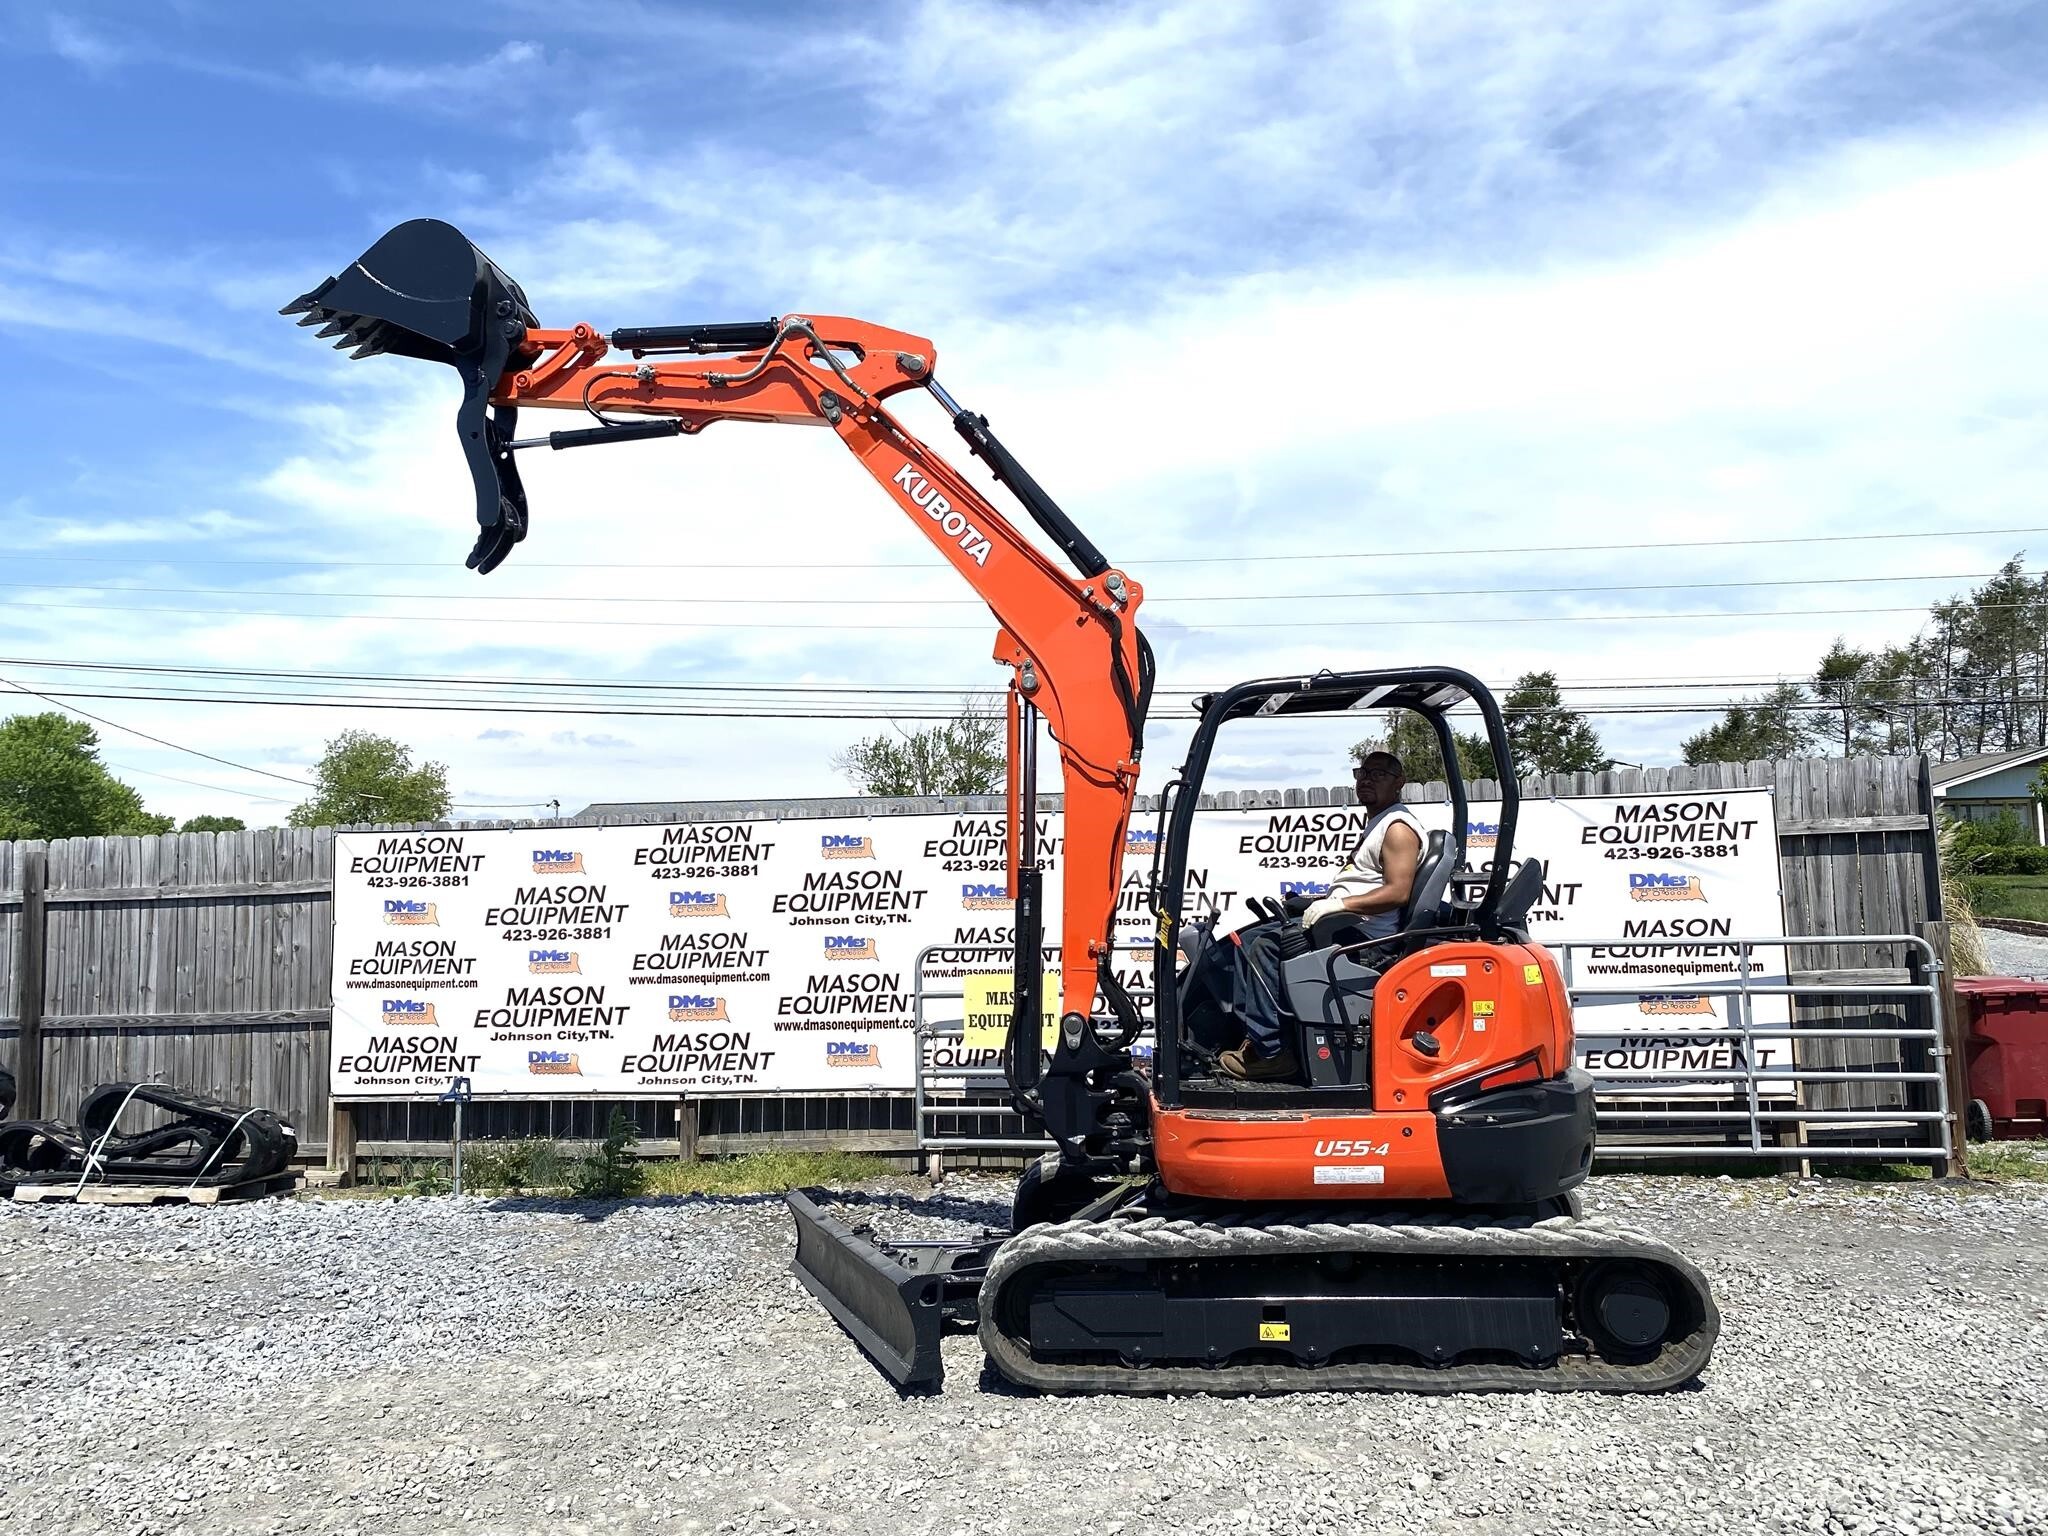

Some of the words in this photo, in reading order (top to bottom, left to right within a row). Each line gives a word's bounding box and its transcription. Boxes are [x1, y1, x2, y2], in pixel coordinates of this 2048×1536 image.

[892, 462, 993, 568] KUBOTA
[1614, 801, 1727, 823] MASON
[952, 819, 1048, 838] MASN
[1268, 813, 1368, 833] MASON
[662, 825, 752, 845] MASON
[1581, 821, 1758, 845] EQUIPMENT
[377, 837, 463, 855] MASON
[1239, 833, 1363, 853] EQUIPME
[1604, 844, 1739, 860] 423-926-3881
[634, 843, 775, 865] EQUIPMENT
[350, 855, 485, 873] EQUIPMENT
[652, 865, 759, 879] 423-926-3881
[367, 876, 469, 888] 423-926-3881
[803, 870, 902, 891] MASON
[514, 885, 606, 905] MASON
[772, 890, 928, 913] EQUIPMENT
[485, 904, 629, 926] EQUIPMENT
[789, 915, 849, 926] Johnson
[855, 914, 912, 926] City,TN.
[502, 927, 612, 941] 423-926-3881
[1623, 918, 1731, 938] MASON
[374, 940, 456, 957] MASON
[660, 932, 748, 950] MASON
[350, 958, 476, 975] EQUIPMENT
[632, 950, 769, 970] EQUIPMENT
[346, 978, 478, 991] www.dmasonequipment.com
[629, 972, 770, 986] www.dmasonequipment.com
[806, 973, 900, 994] MASON
[505, 986, 605, 1007] MASON
[473, 1006, 630, 1029] EQUIPMENT
[774, 1018, 916, 1033] www.dmasonequipment.co
[367, 1036, 458, 1054] MASON
[490, 1031, 552, 1042] Johnson
[557, 1030, 614, 1042] City,TN.
[652, 1032, 750, 1053] MASON
[338, 1055, 481, 1074] EQUIPMENT
[621, 1052, 775, 1074] EQUIPMENT
[1585, 1049, 1776, 1070] EQUIPMENT
[354, 1076, 410, 1085] Johnson
[637, 1076, 696, 1086] Johnson
[701, 1074, 758, 1086] City,TN.
[1314, 1140, 1390, 1157] U55-4
